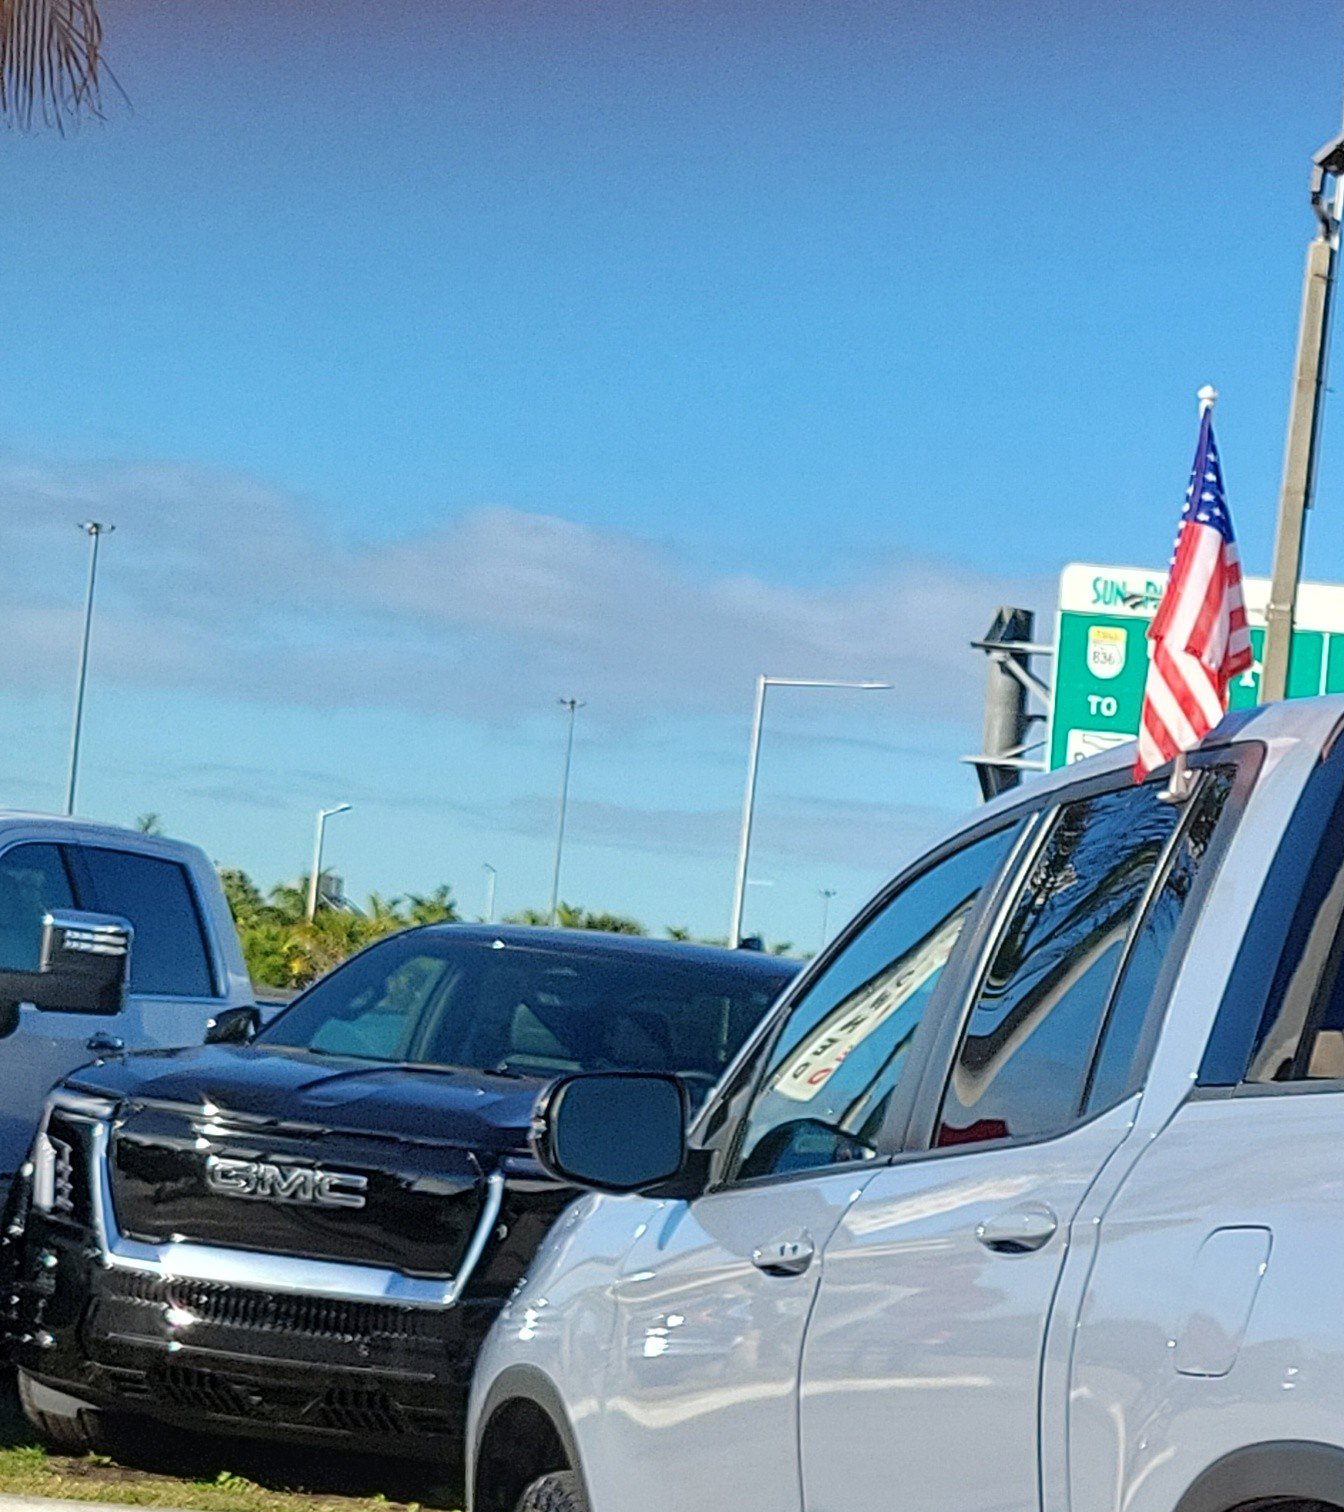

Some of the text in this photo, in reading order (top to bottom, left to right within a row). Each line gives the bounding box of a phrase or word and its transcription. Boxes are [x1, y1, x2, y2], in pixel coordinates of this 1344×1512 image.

[1091, 577, 1127, 606] SUN
[1088, 695, 1117, 716] TO
[207, 1156, 368, 1209] GMC
